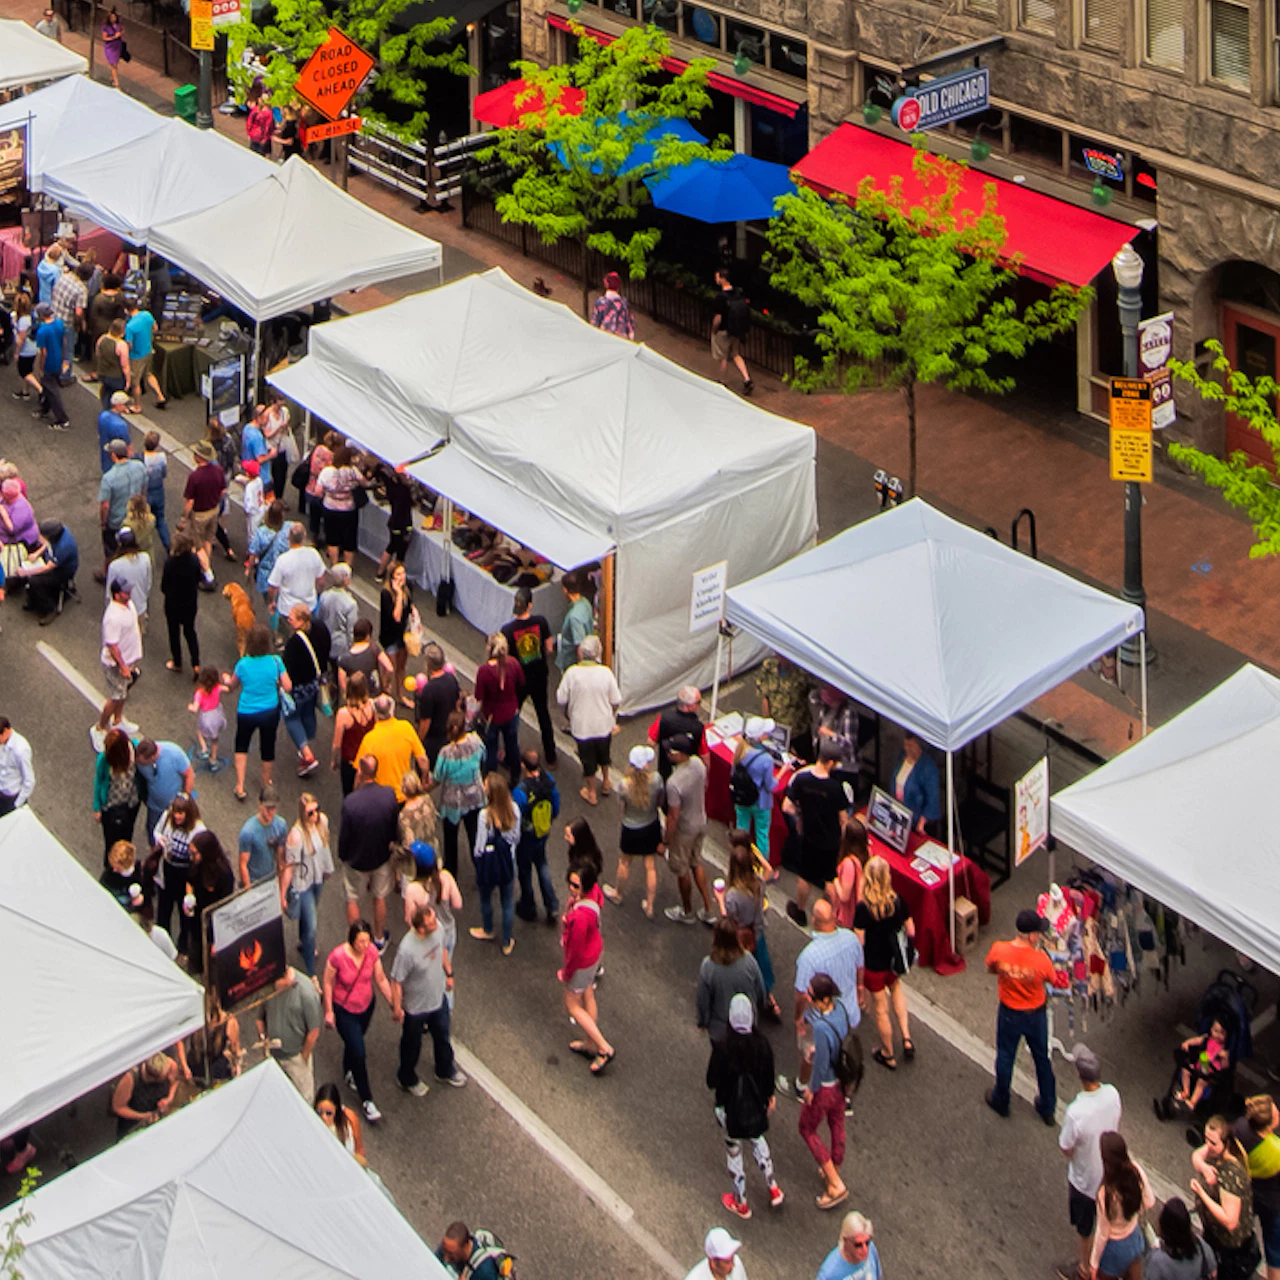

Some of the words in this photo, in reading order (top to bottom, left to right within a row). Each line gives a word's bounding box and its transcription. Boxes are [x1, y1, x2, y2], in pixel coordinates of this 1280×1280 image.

[320, 44, 353, 62] ROAD
[312, 60, 359, 83] CLOSED
[316, 78, 356, 99] AHEAD
[920, 90, 940, 118] OLD
[940, 75, 986, 110] CHICAGO
[311, 129, 320, 139] N
